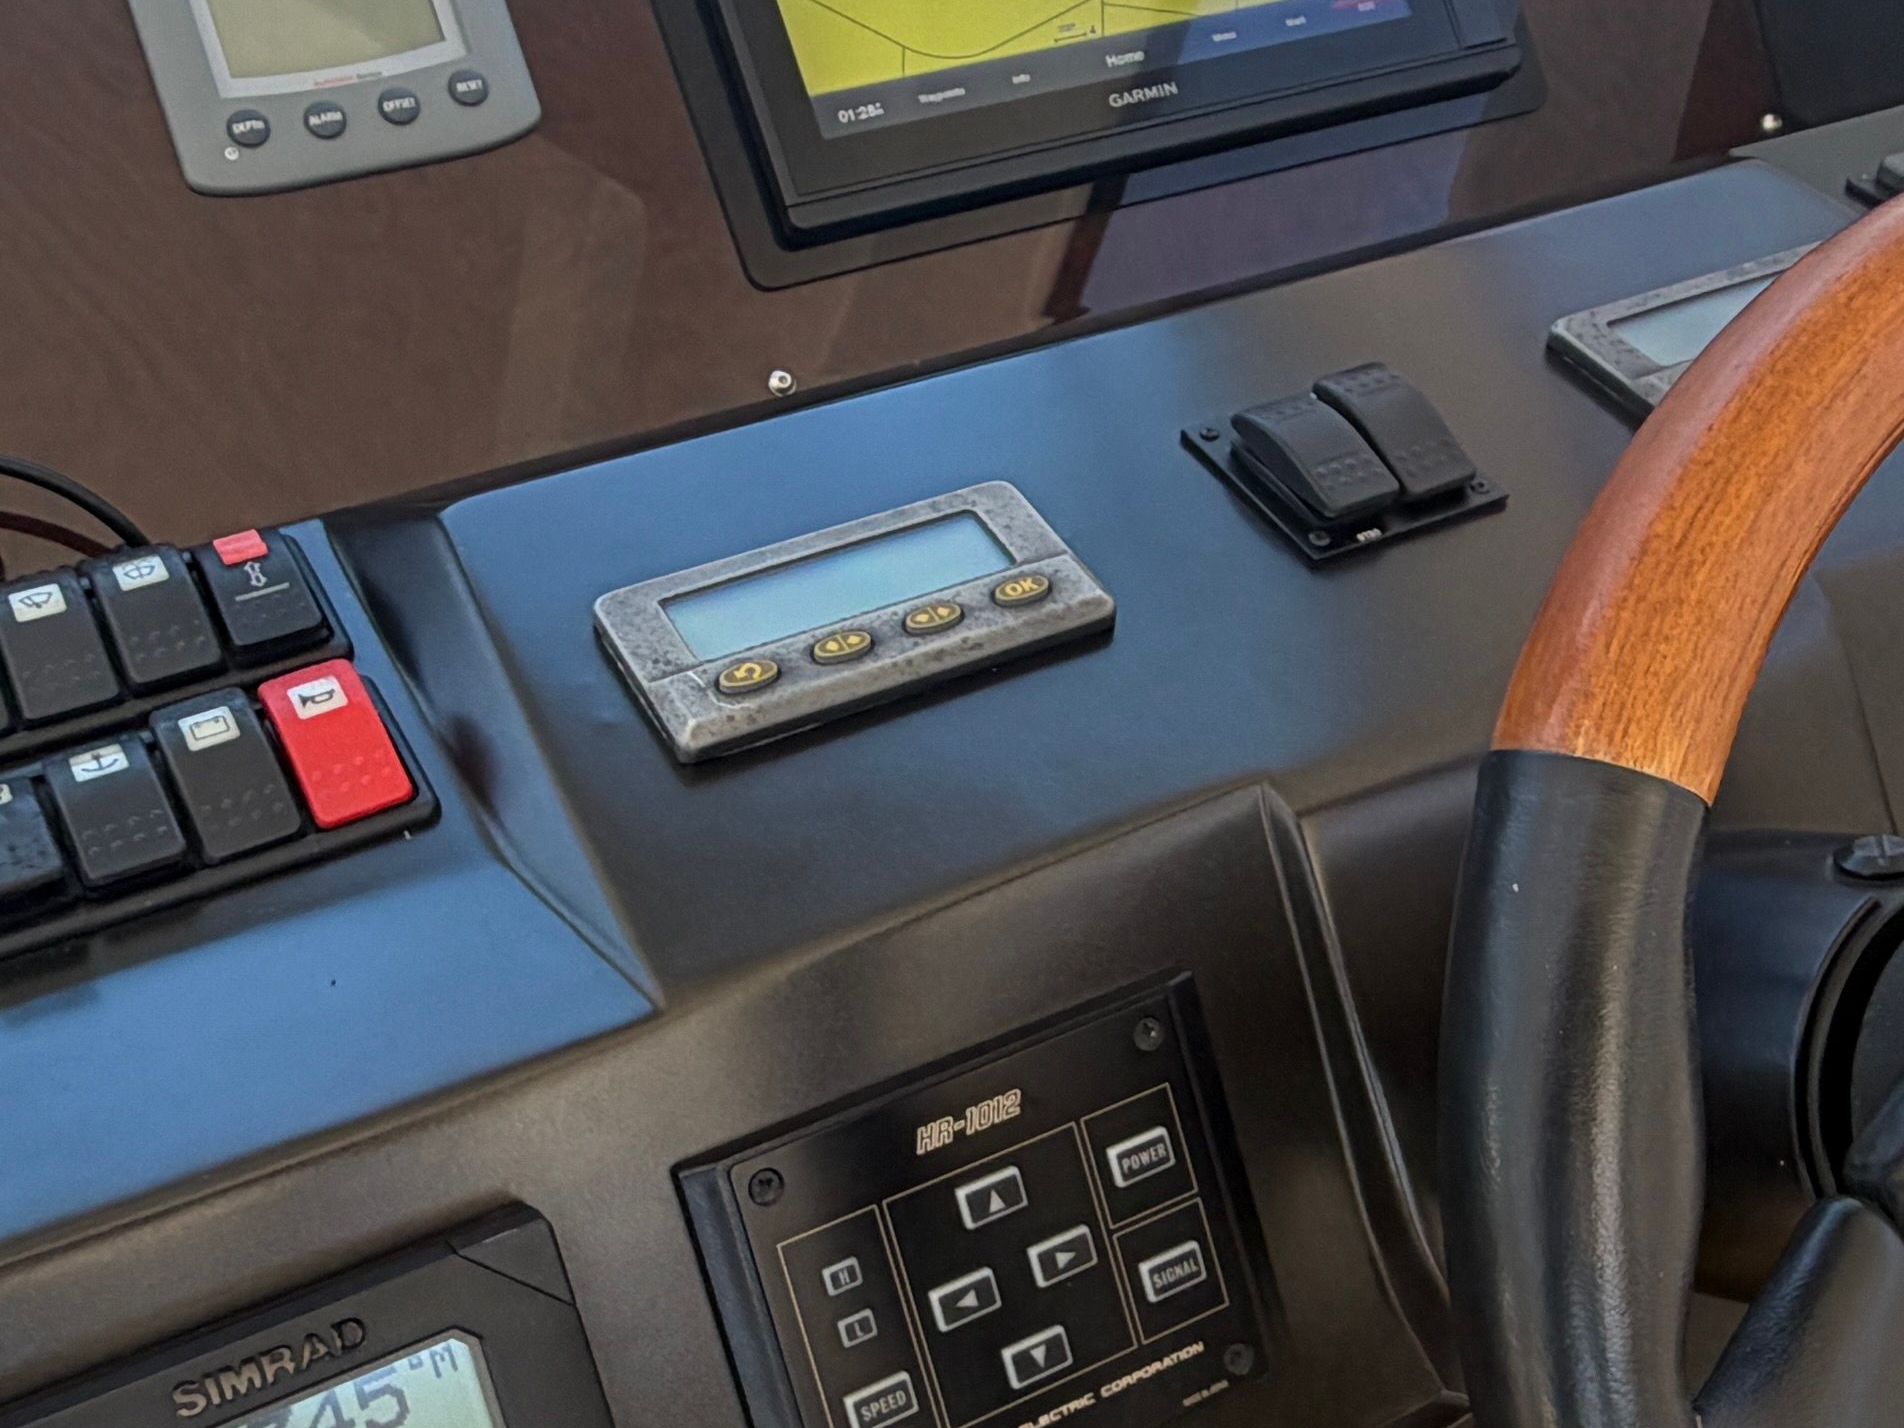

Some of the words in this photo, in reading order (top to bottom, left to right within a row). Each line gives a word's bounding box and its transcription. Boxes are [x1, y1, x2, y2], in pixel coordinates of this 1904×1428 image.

[1109, 81, 1179, 108] GARMIN
[308, 110, 344, 126] ALARM
[1007, 576, 1038, 597] OK
[915, 1088, 1022, 1156] HR-1012
[1121, 1142, 1167, 1173] POWER
[1152, 1257, 1200, 1289] SIGNAL
[171, 1317, 367, 1419] SIMRAD
[1100, 1340, 1206, 1399] CORPORATION
[859, 1389, 907, 1422] SPEED
